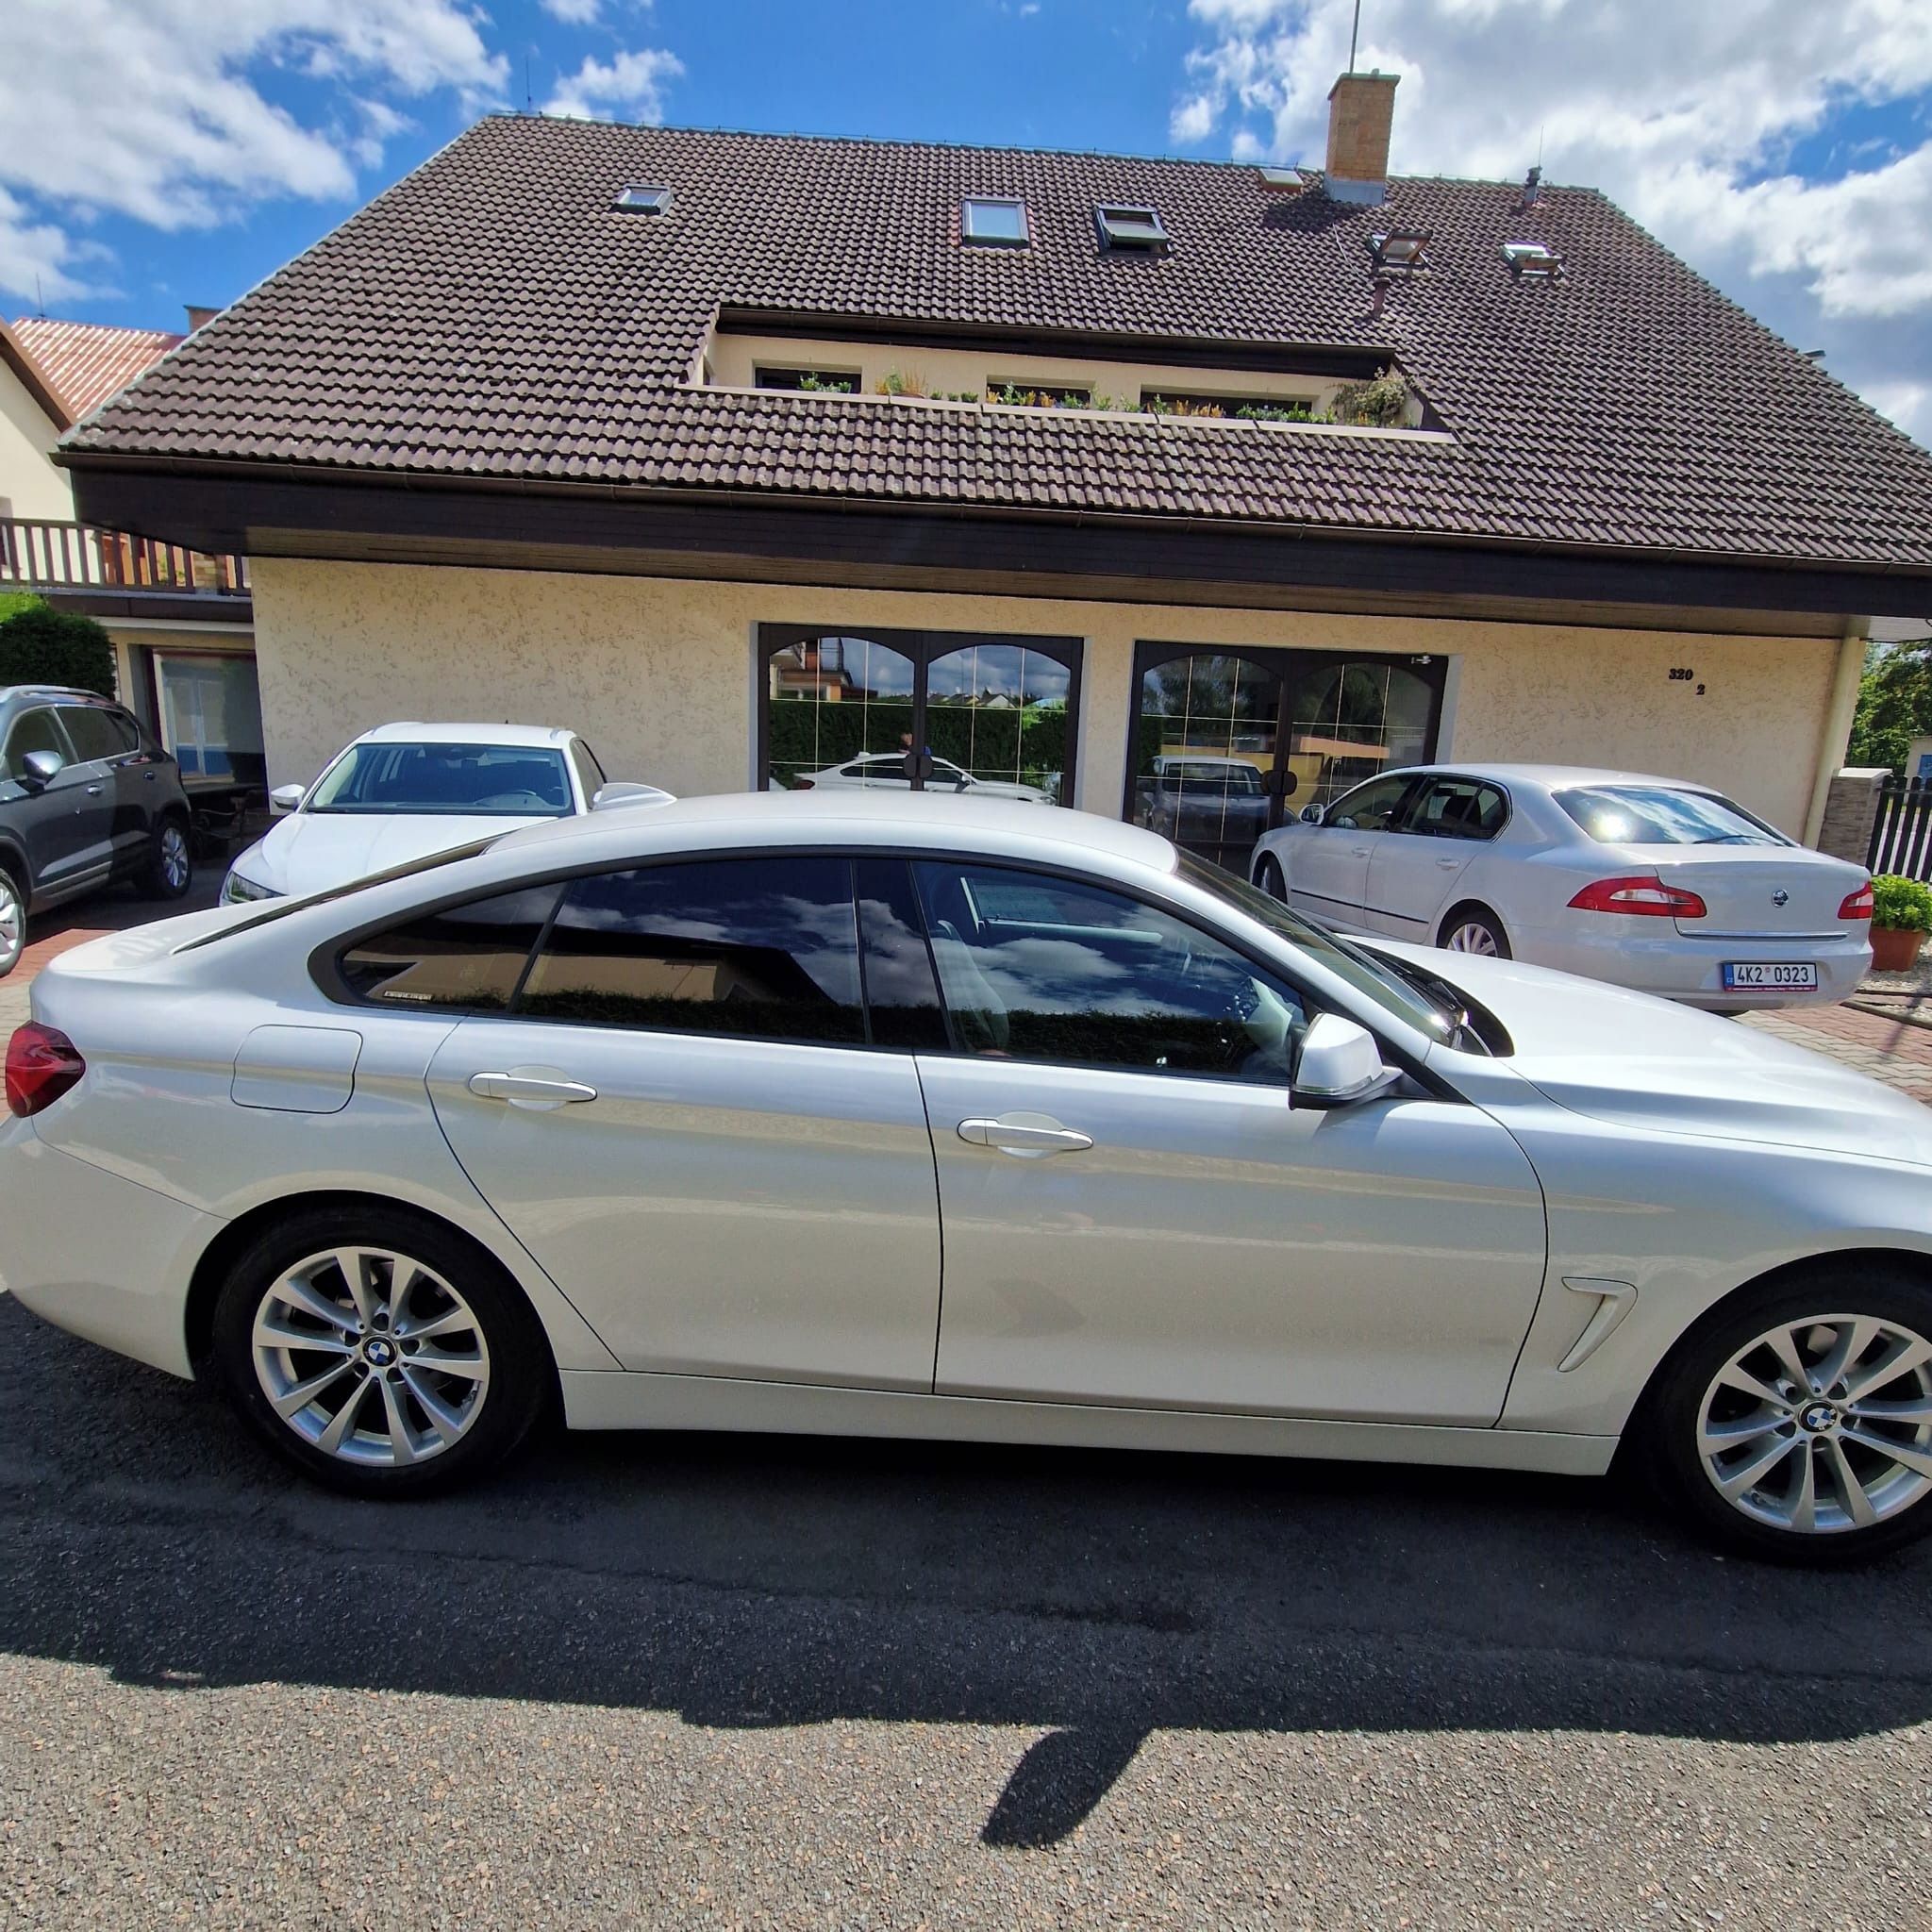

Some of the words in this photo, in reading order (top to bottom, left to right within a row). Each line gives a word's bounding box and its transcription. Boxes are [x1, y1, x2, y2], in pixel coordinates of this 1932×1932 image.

[1668, 668, 1693, 680] 320
[1696, 684, 1706, 695] 2
[1737, 966, 1763, 983] 4K2
[1774, 966, 1809, 983] 0323
